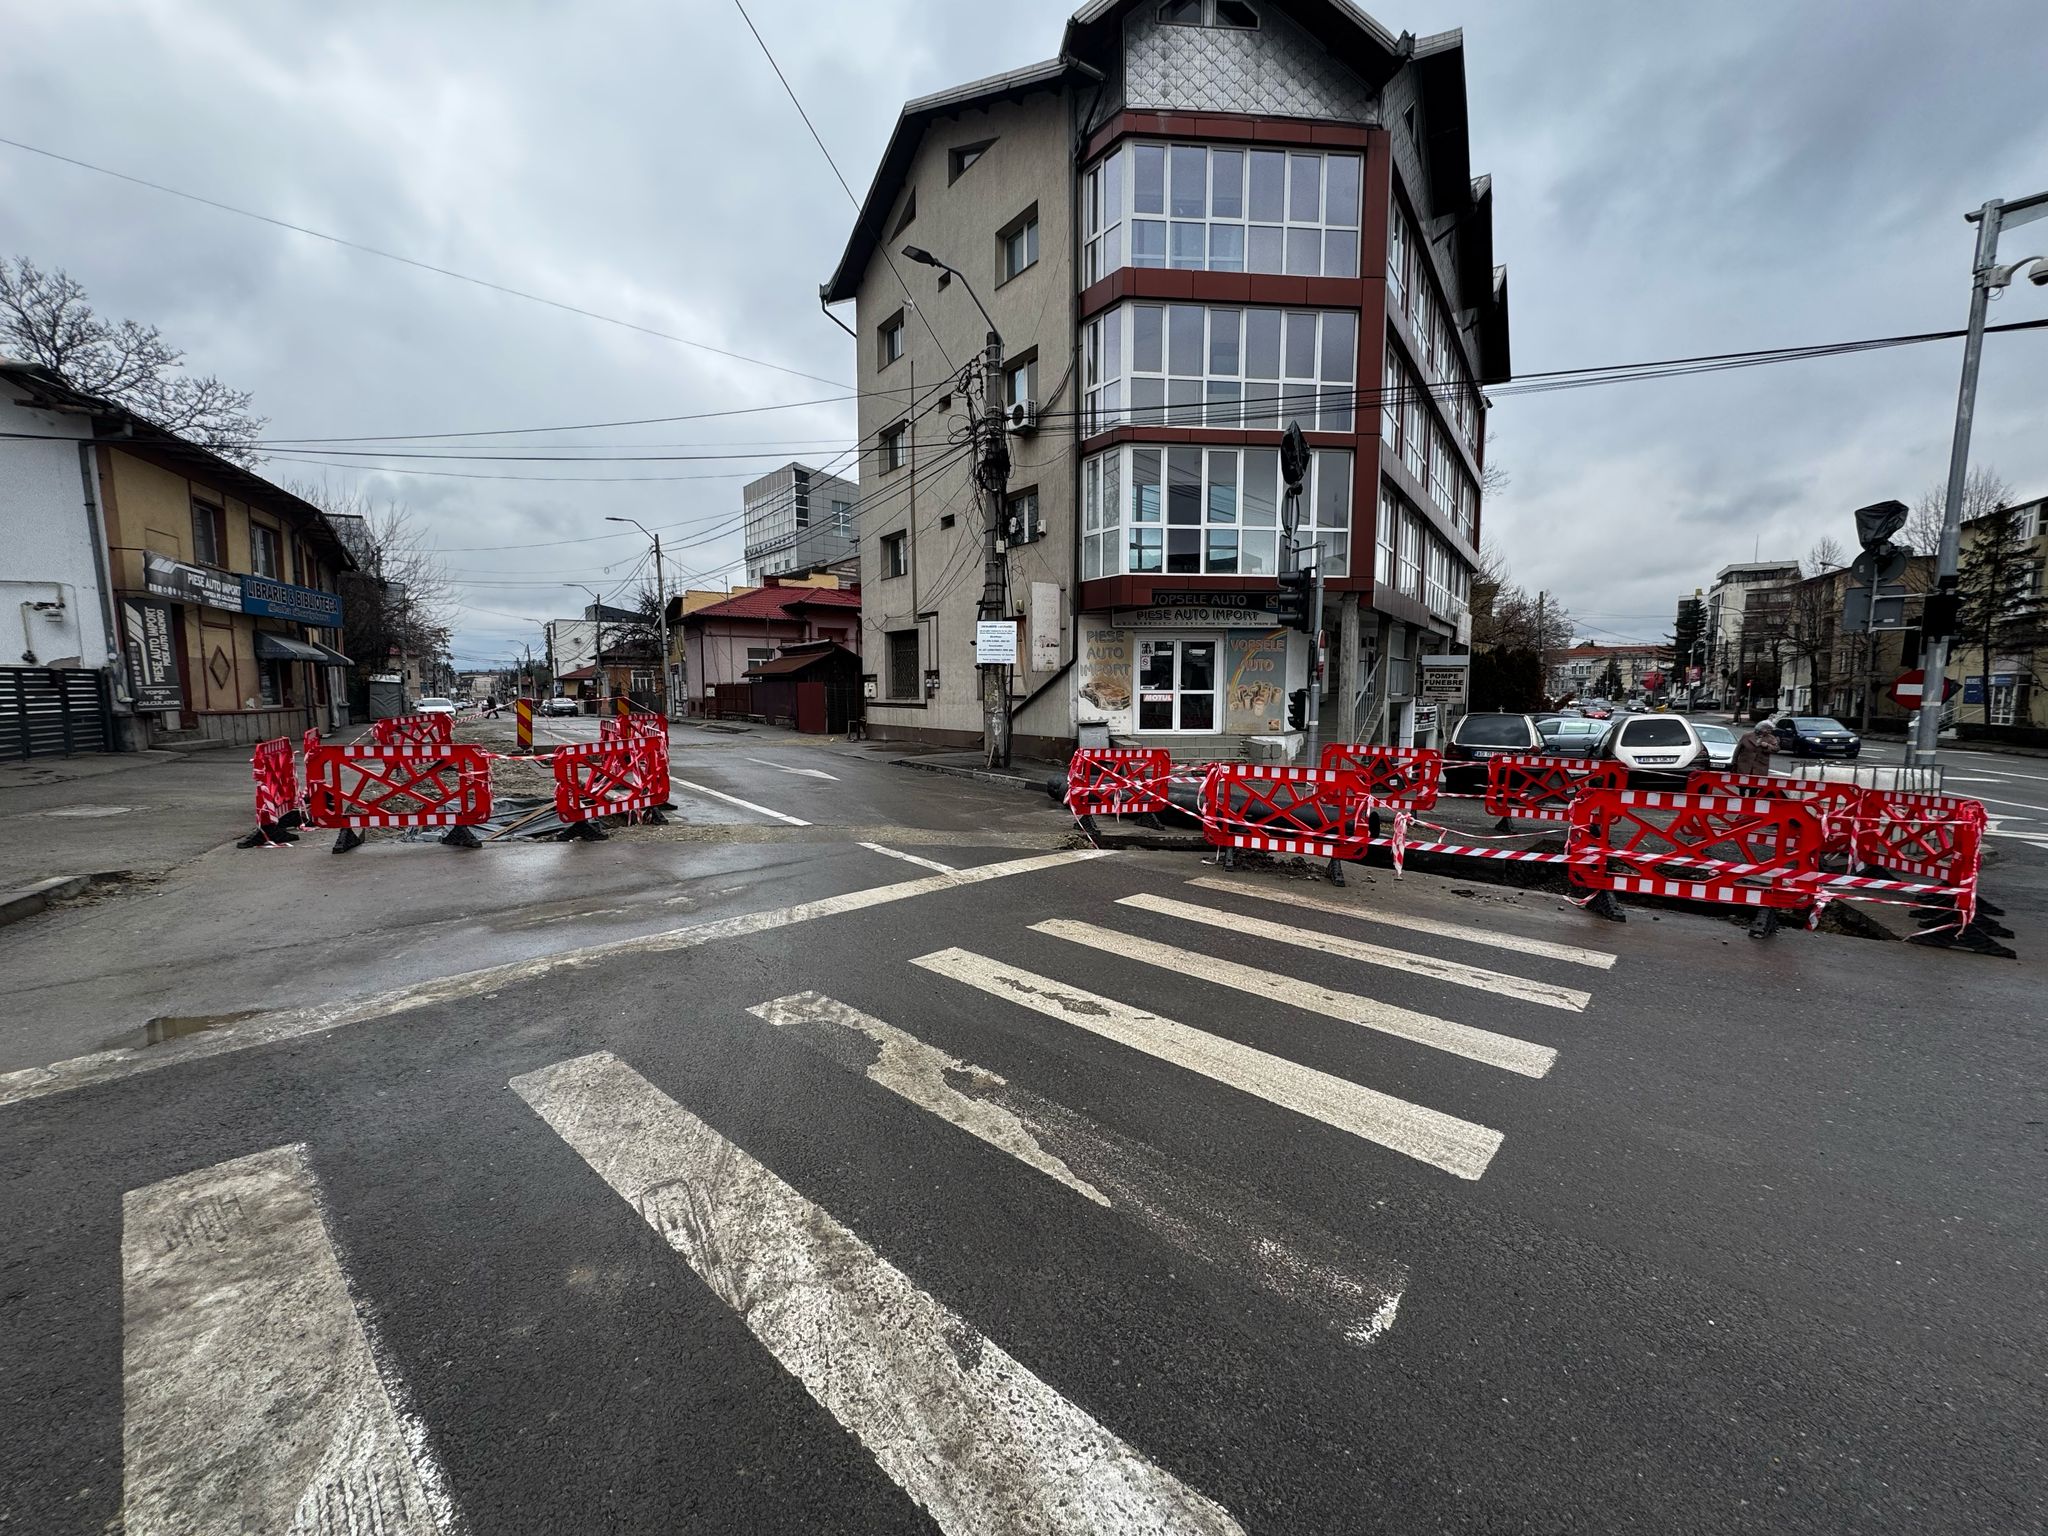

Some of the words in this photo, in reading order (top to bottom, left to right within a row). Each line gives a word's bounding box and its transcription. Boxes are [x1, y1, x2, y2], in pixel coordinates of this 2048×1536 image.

[187, 573, 205, 588] PIESE
[205, 578, 221, 592] AUTO
[221, 582, 241, 597] IMPORT
[246, 579, 287, 605] LIBRARIE
[287, 589, 295, 606] &
[295, 590, 339, 615] BIBLIOTECA
[1211, 594, 1247, 606] AUTO
[144, 606, 159, 637] IMPORT
[1136, 609, 1172, 620] PIESE
[1174, 609, 1209, 620] AUTO
[1212, 609, 1260, 621] IMPORT
[159, 635, 170, 652] AUTO
[1086, 630, 1125, 643] PIESE
[148, 638, 162, 660] AUTO
[1230, 639, 1285, 651] VOPSELE
[161, 652, 172, 667] PIESE
[1086, 647, 1124, 660] AUTO
[152, 661, 166, 683] PIESE
[1080, 663, 1131, 677] IMPORT
[1242, 659, 1274, 672] AUTO
